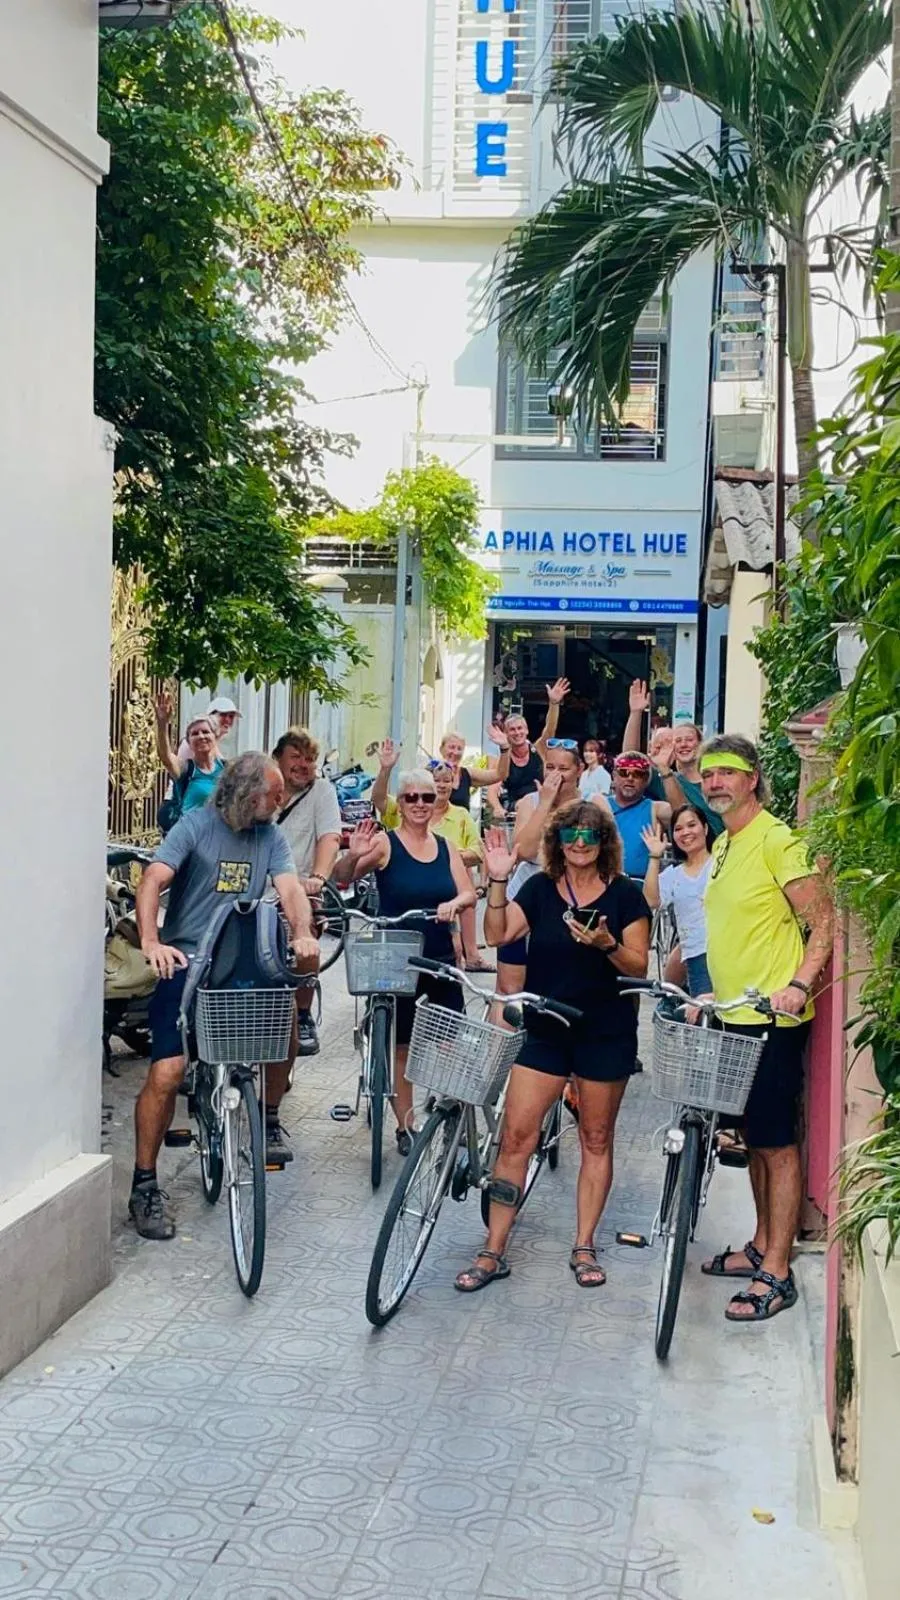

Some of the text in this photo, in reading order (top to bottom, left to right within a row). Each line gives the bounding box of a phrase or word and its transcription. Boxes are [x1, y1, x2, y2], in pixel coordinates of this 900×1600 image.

[475, 0, 515, 177] UE
[484, 530, 687, 554] APHIA HOTEL HUE
[531, 559, 626, 577] Massage & Spa
